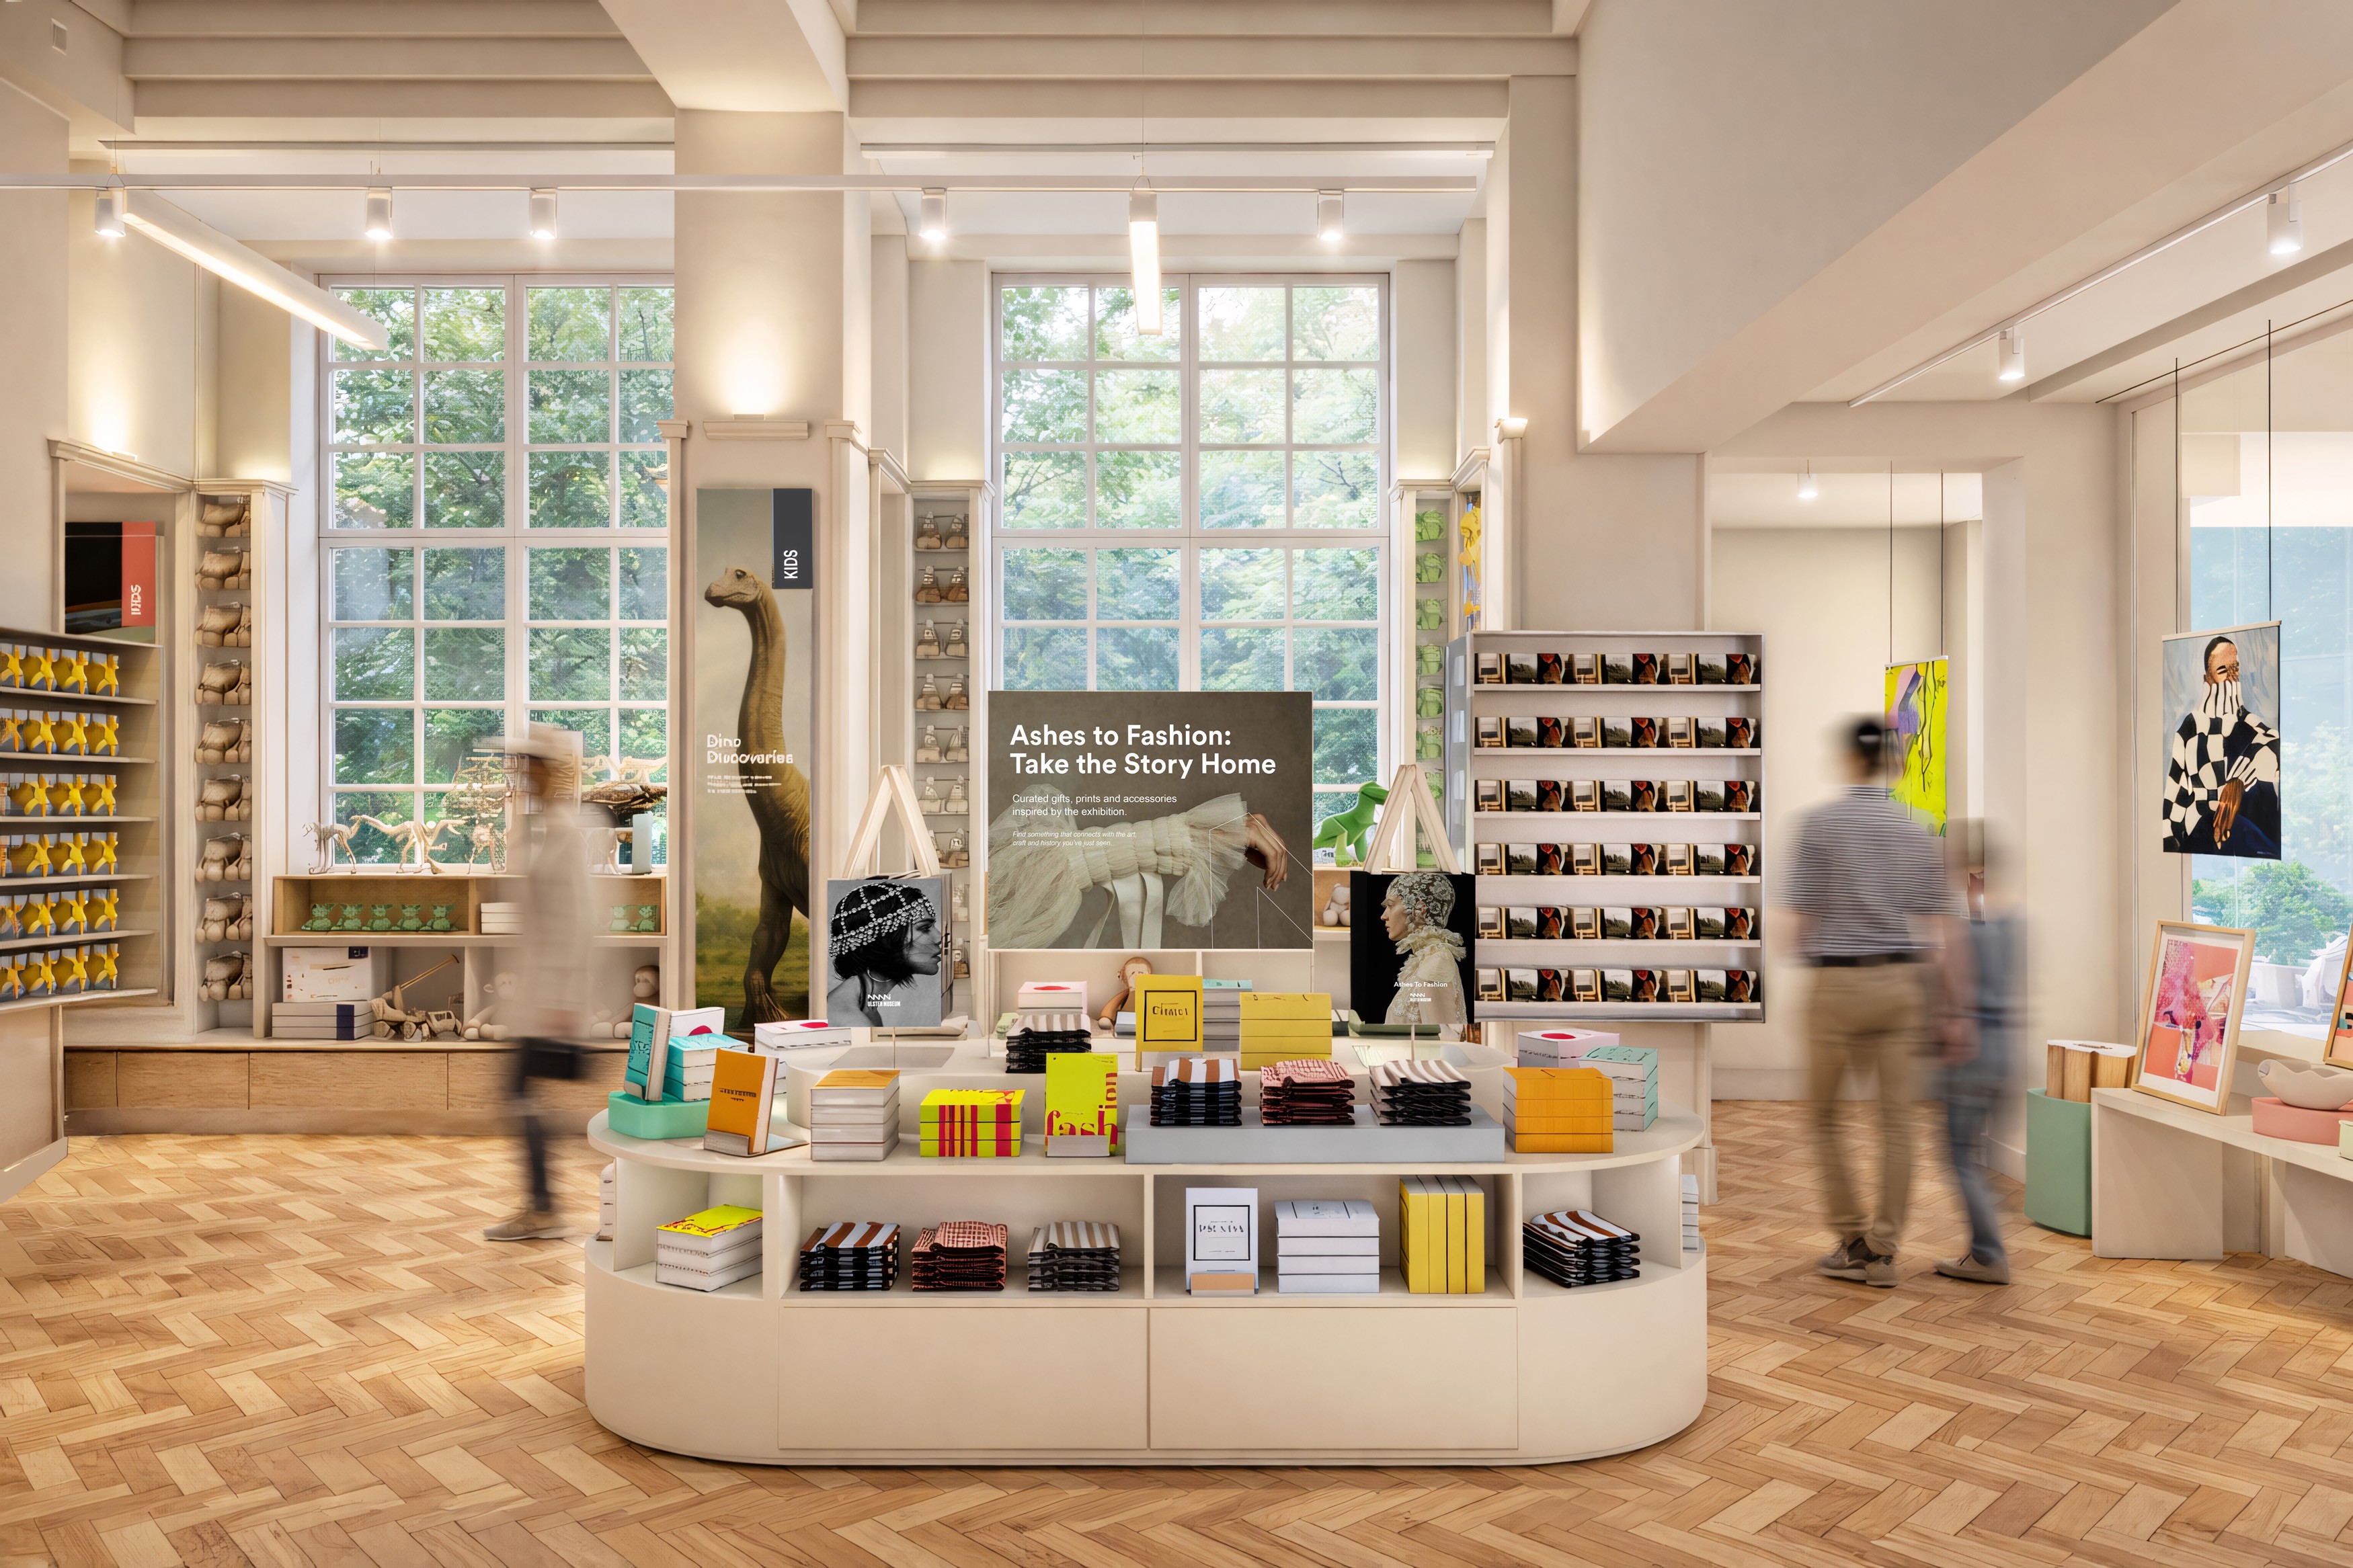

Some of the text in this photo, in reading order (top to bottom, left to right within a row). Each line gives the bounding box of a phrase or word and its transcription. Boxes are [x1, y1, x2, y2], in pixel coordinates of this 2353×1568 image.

[783, 550, 798, 579] KIDS
[1010, 723, 1231, 745] Ashes to Fashion:
[1010, 752, 1276, 780] Take the Story Home
[1012, 794, 1177, 805] Curated gifts, prints and accessories
[1012, 807, 1127, 818] inspired by the exhibition.
[1027, 831, 1059, 839] something
[1040, 839, 1062, 848] history
[1082, 839, 1094, 848] just
